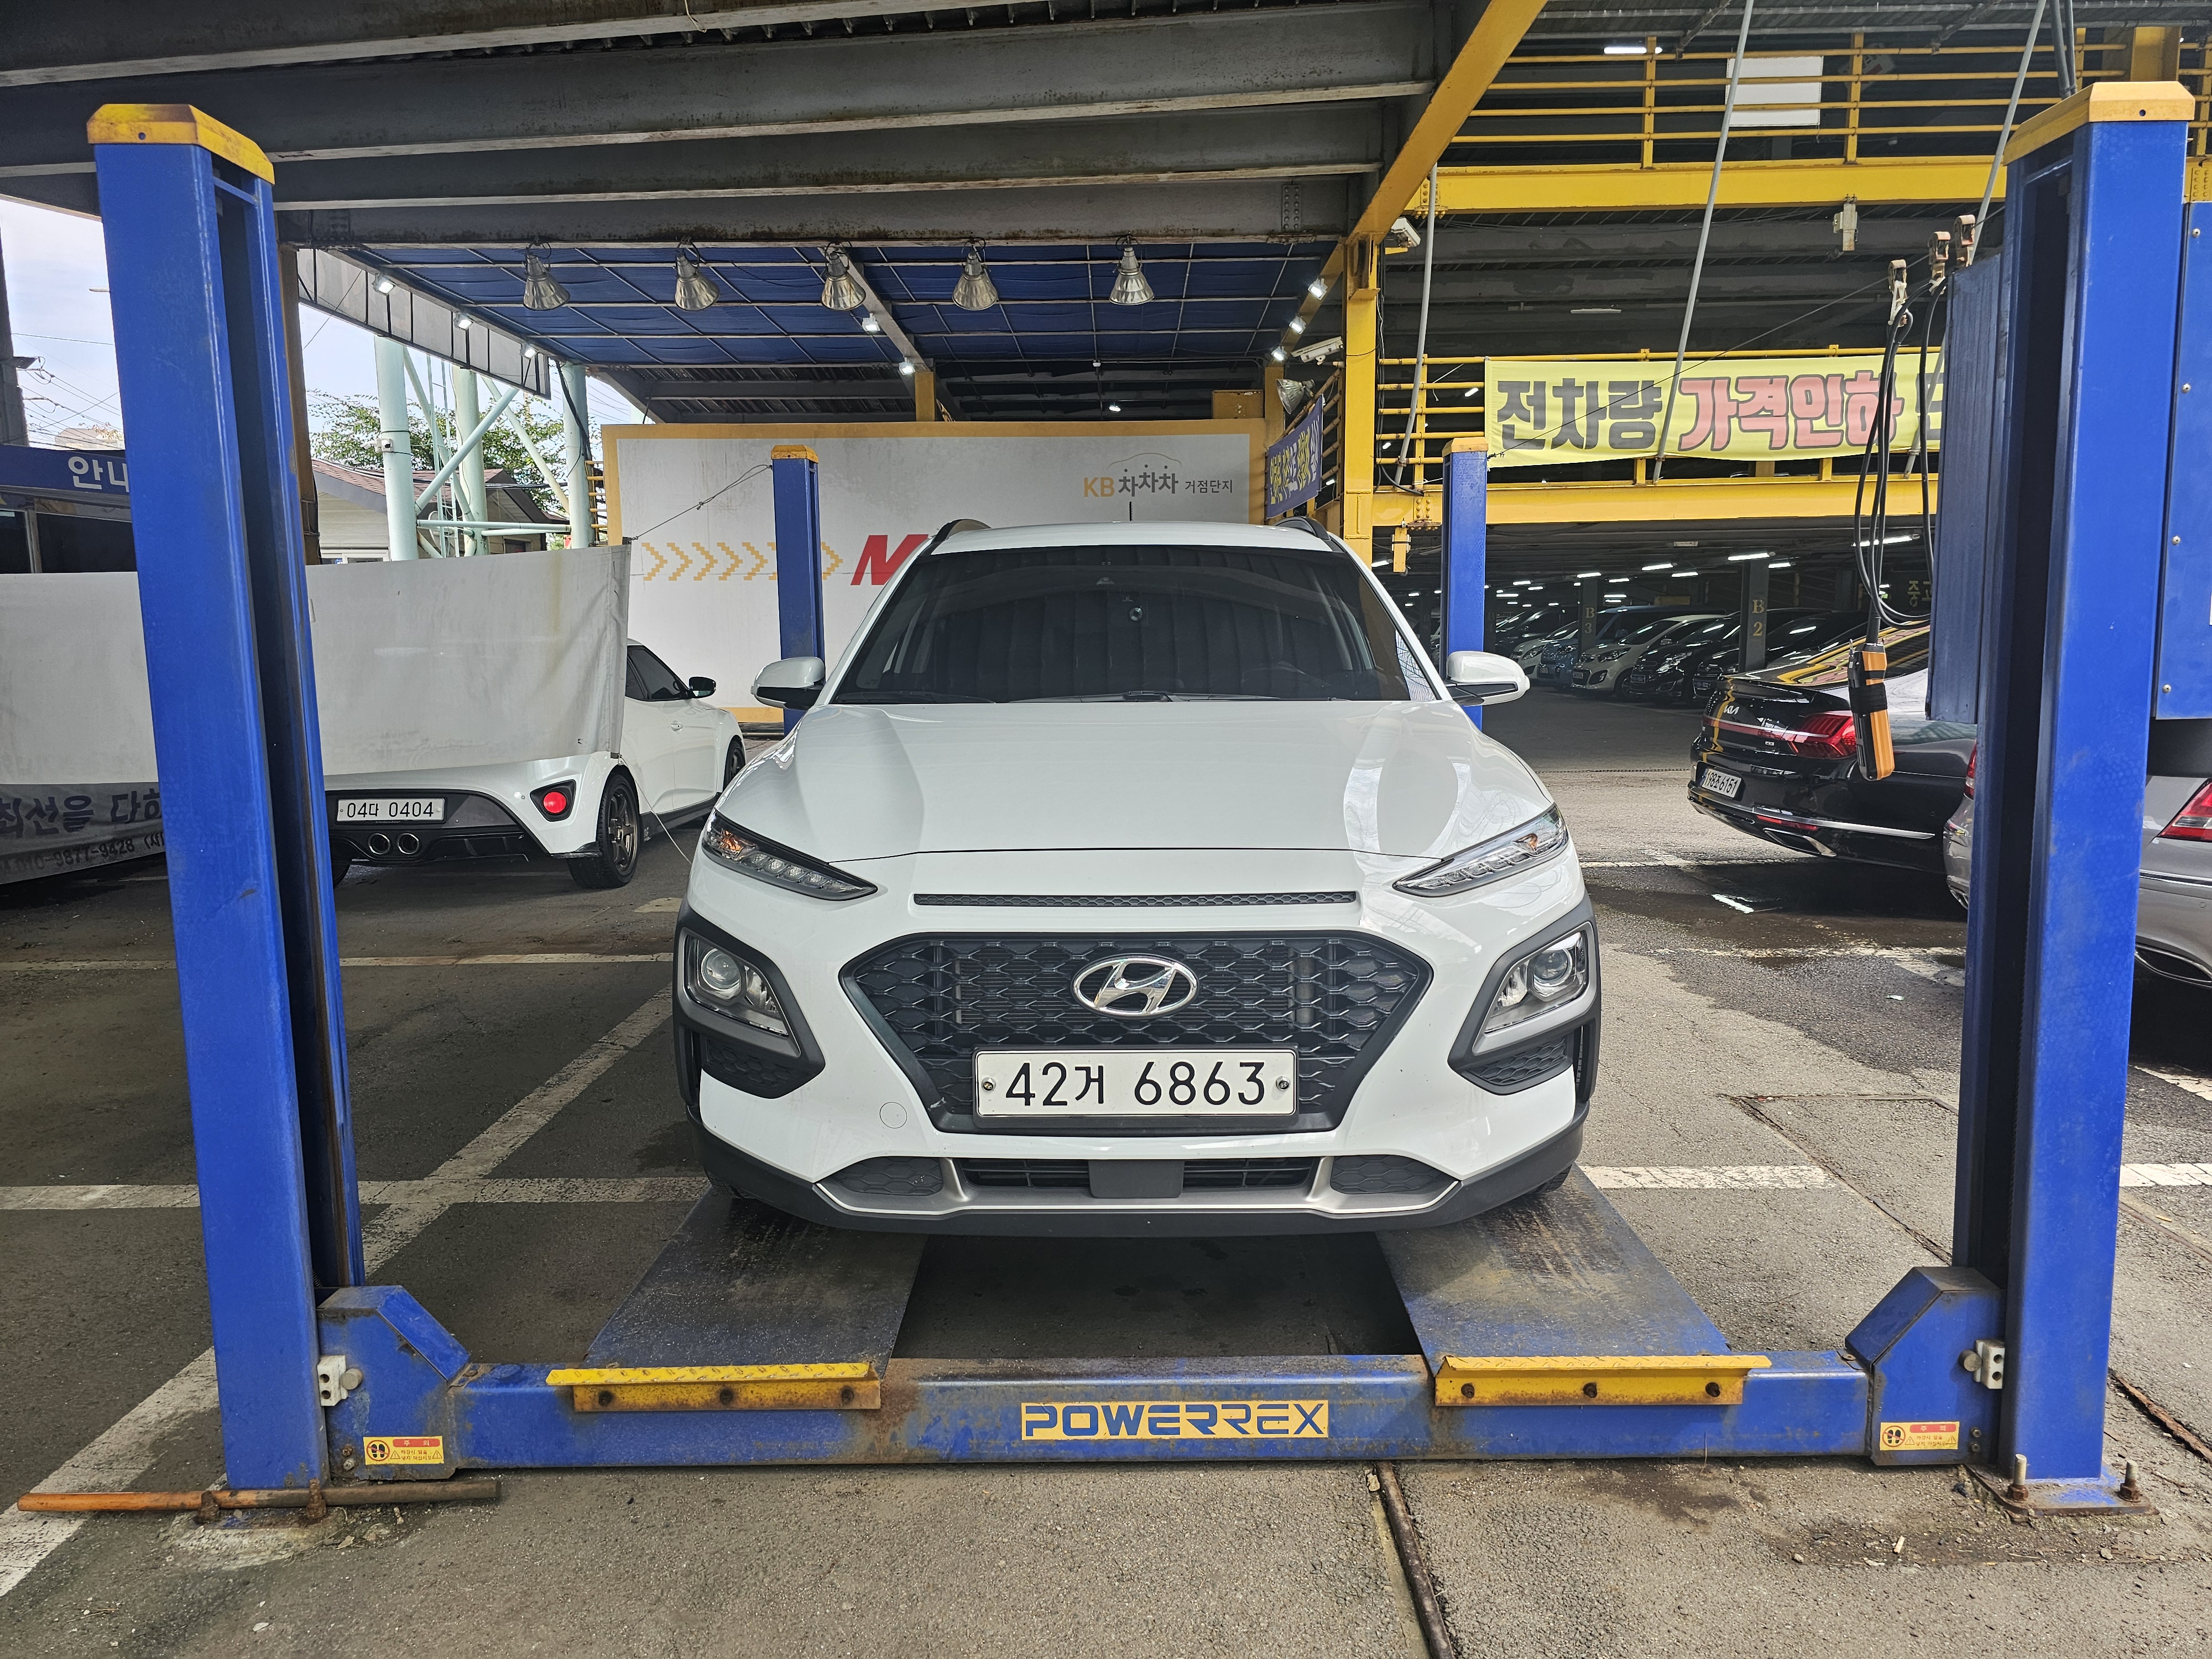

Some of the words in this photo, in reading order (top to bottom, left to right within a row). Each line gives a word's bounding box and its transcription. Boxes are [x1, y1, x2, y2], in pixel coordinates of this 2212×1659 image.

[1497, 378, 1662, 450] 전차량
[1678, 370, 1905, 452] 가격인하
[1185, 479, 1233, 494] 거점단지
[1752, 599, 1765, 613] B
[1753, 622, 1763, 637] 2
[347, 802, 379, 818] 04다
[389, 802, 434, 817] 0404
[1005, 1062, 1104, 1107] 42거
[1134, 1061, 1265, 1106] 6863
[1025, 1402, 1325, 1437] POWERREX
